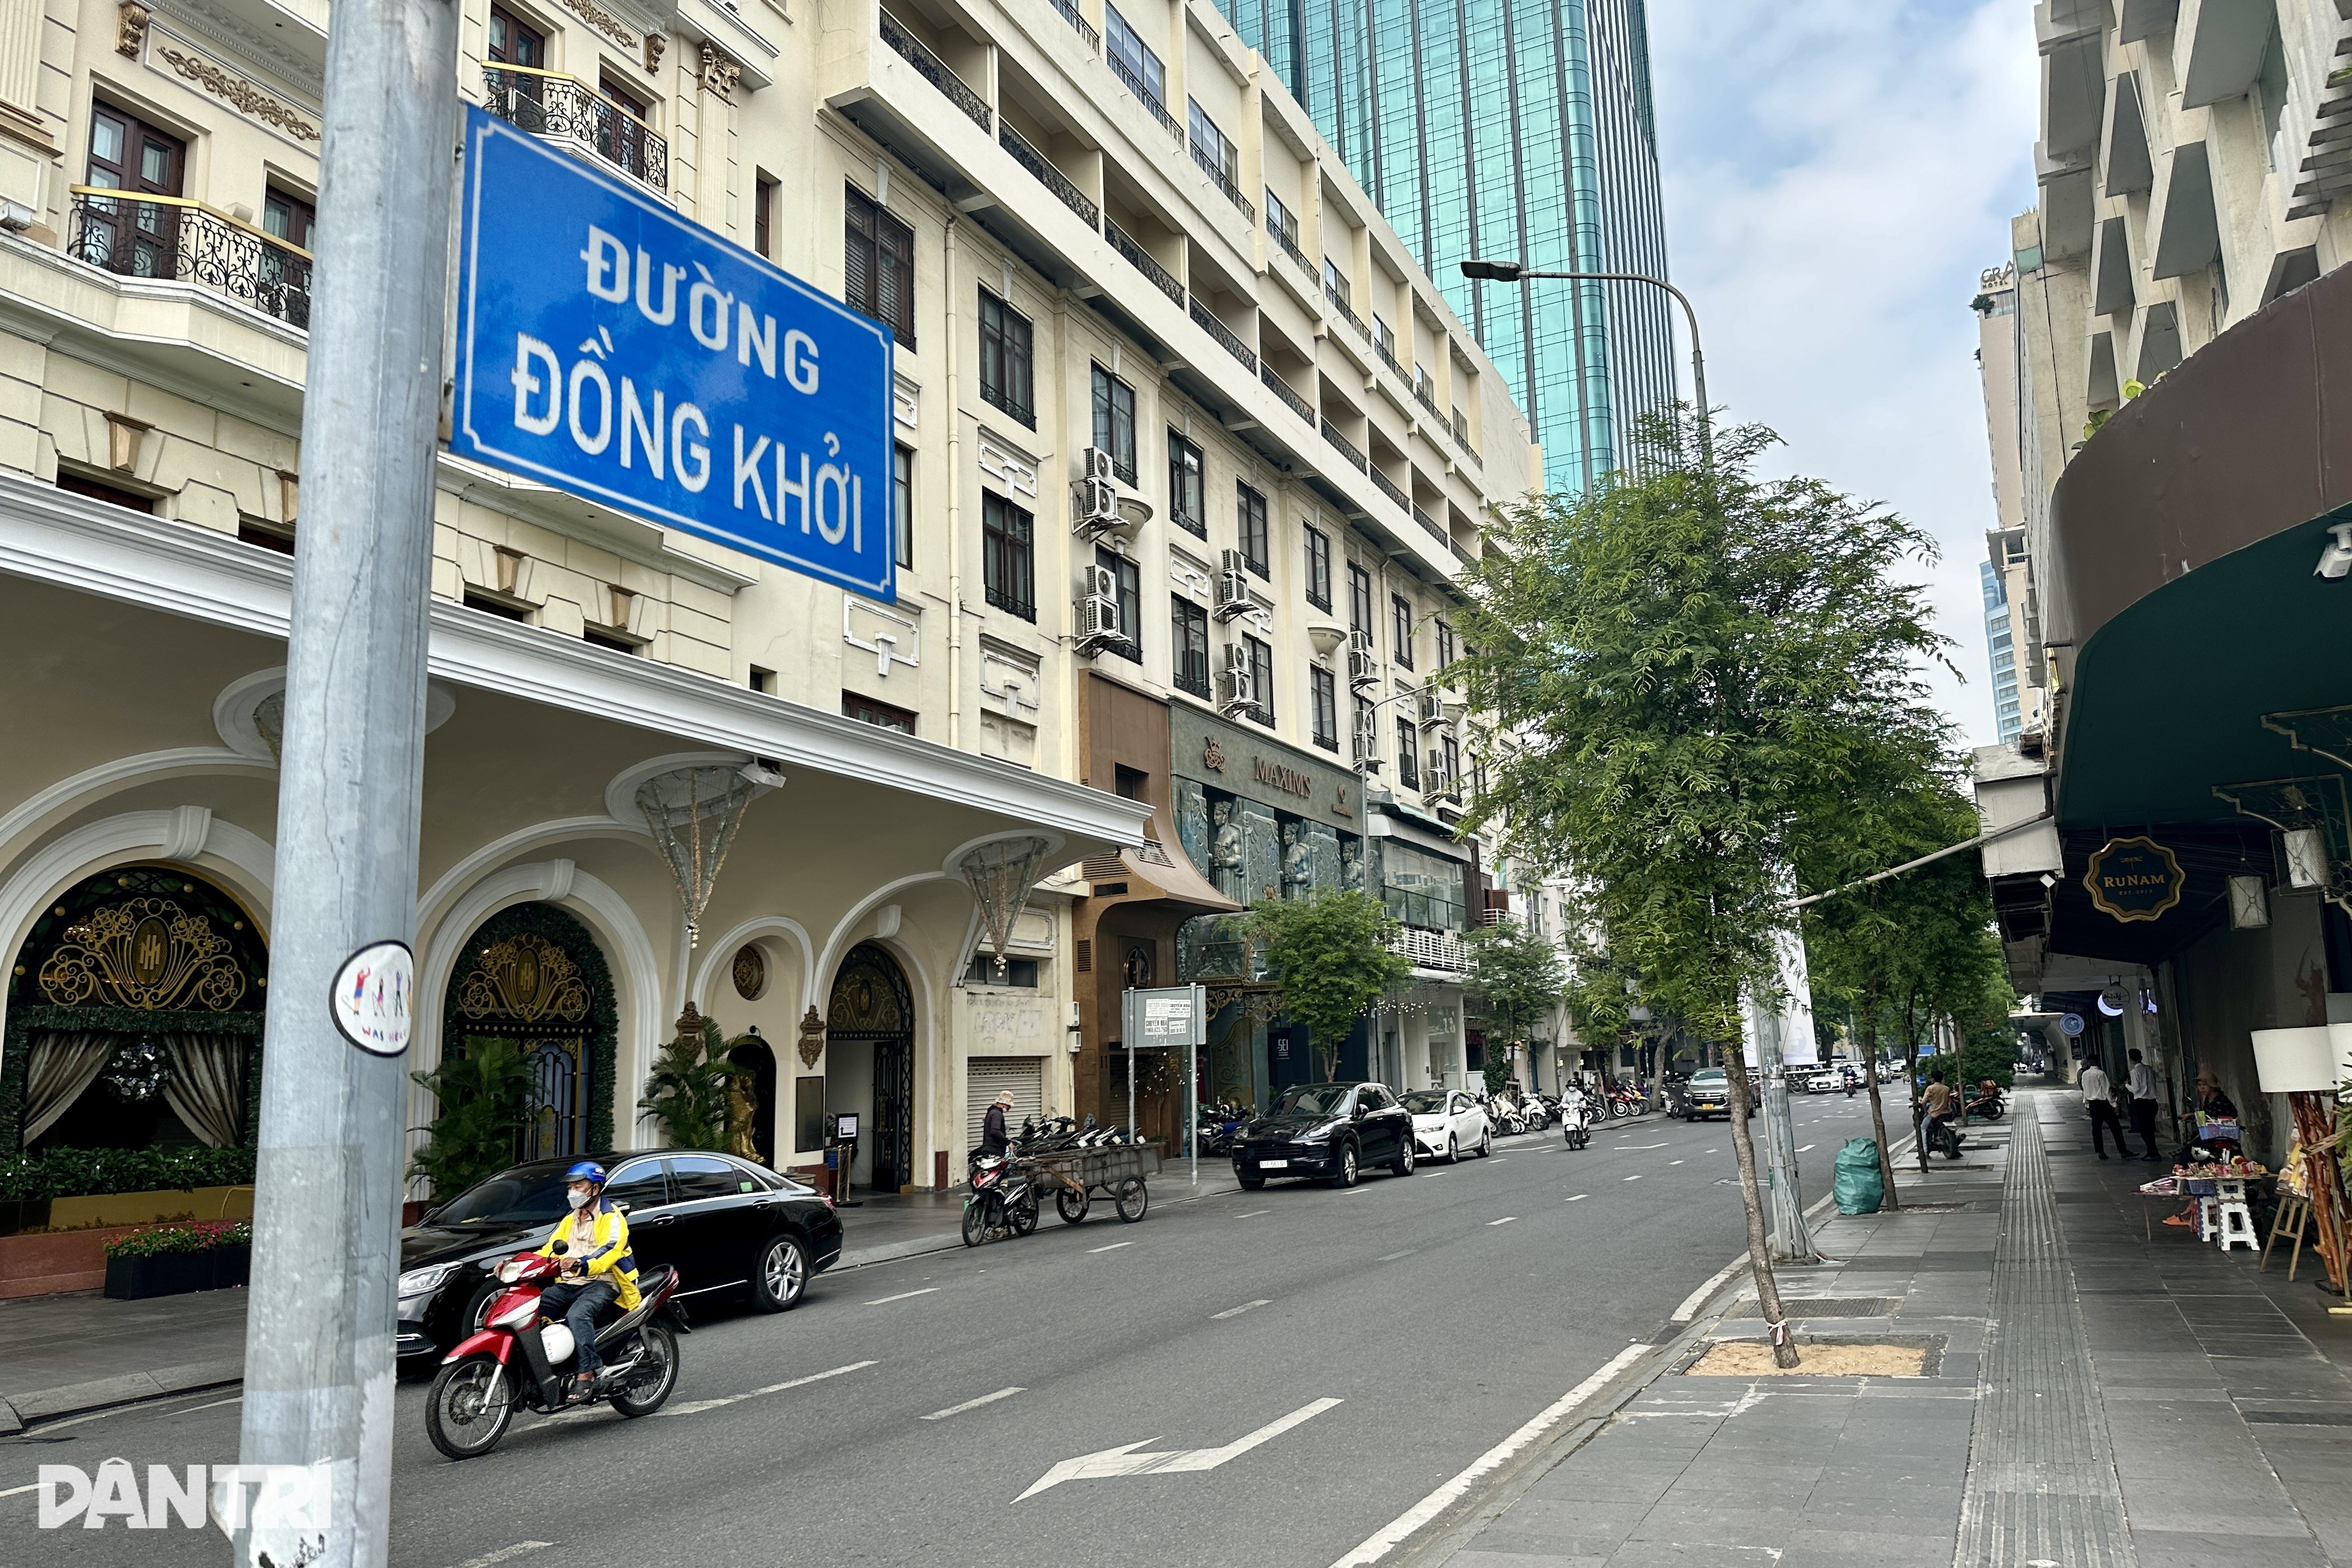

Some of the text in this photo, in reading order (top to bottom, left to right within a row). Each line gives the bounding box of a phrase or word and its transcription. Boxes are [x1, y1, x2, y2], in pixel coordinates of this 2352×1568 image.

[580, 224, 820, 396] ĐƯỜNG
[1982, 280, 2008, 289] HOTEL
[511, 324, 862, 554] ĐỒNG KHỞI
[362, 1026, 384, 1041] WAS
